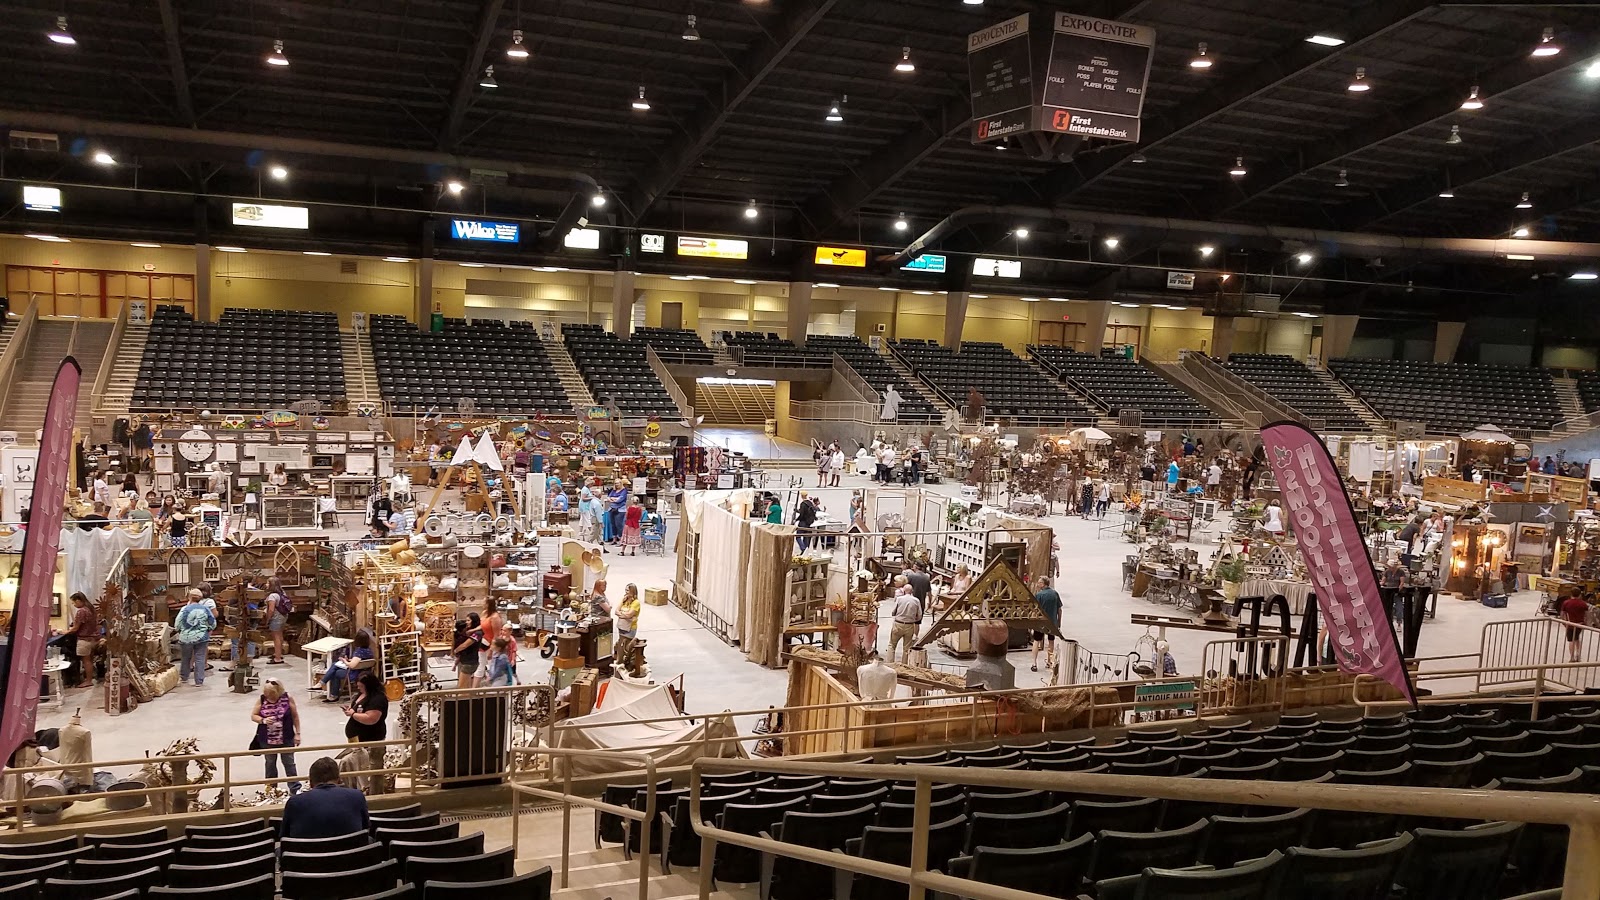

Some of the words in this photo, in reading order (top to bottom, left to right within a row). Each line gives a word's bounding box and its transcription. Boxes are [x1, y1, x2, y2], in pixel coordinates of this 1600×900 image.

[1090, 59, 1108, 67] PERIOD
[1076, 72, 1090, 80] POSS
[1102, 68, 1119, 76] BONUS
[1048, 76, 1065, 84] FOULS
[1083, 81, 1102, 89] PLAYER
[1102, 83, 1116, 91] FOUL
[1126, 87, 1142, 95] FOULS
[988, 119, 1002, 130] First
[1071, 115, 1092, 126] First
[453, 219, 496, 239] Wilco
[9, 389, 65, 742] HUCKLEBERRY
